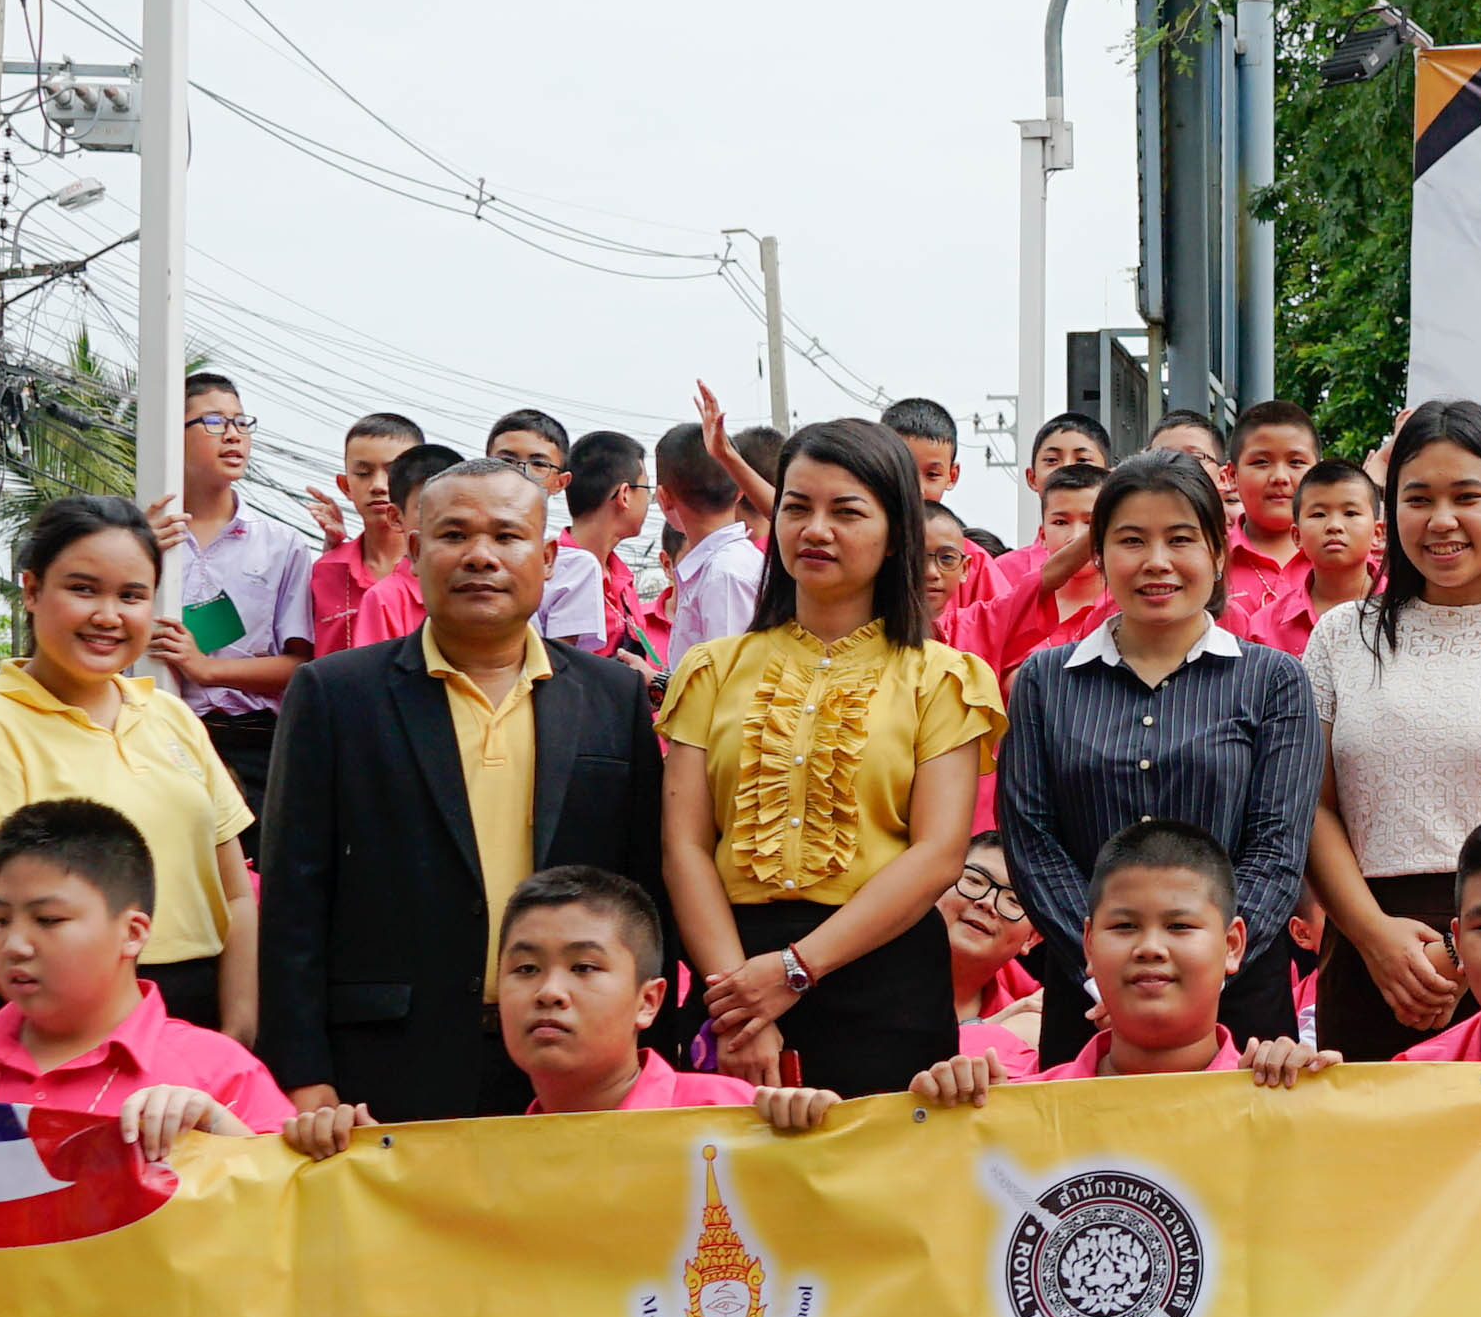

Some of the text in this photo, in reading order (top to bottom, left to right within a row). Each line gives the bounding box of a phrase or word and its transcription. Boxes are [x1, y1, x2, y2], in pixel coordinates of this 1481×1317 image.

[1013, 1241, 1033, 1312] ROYAL
[1057, 1175, 1200, 1311] สำนักงานตำรวจแห่งชาติ
